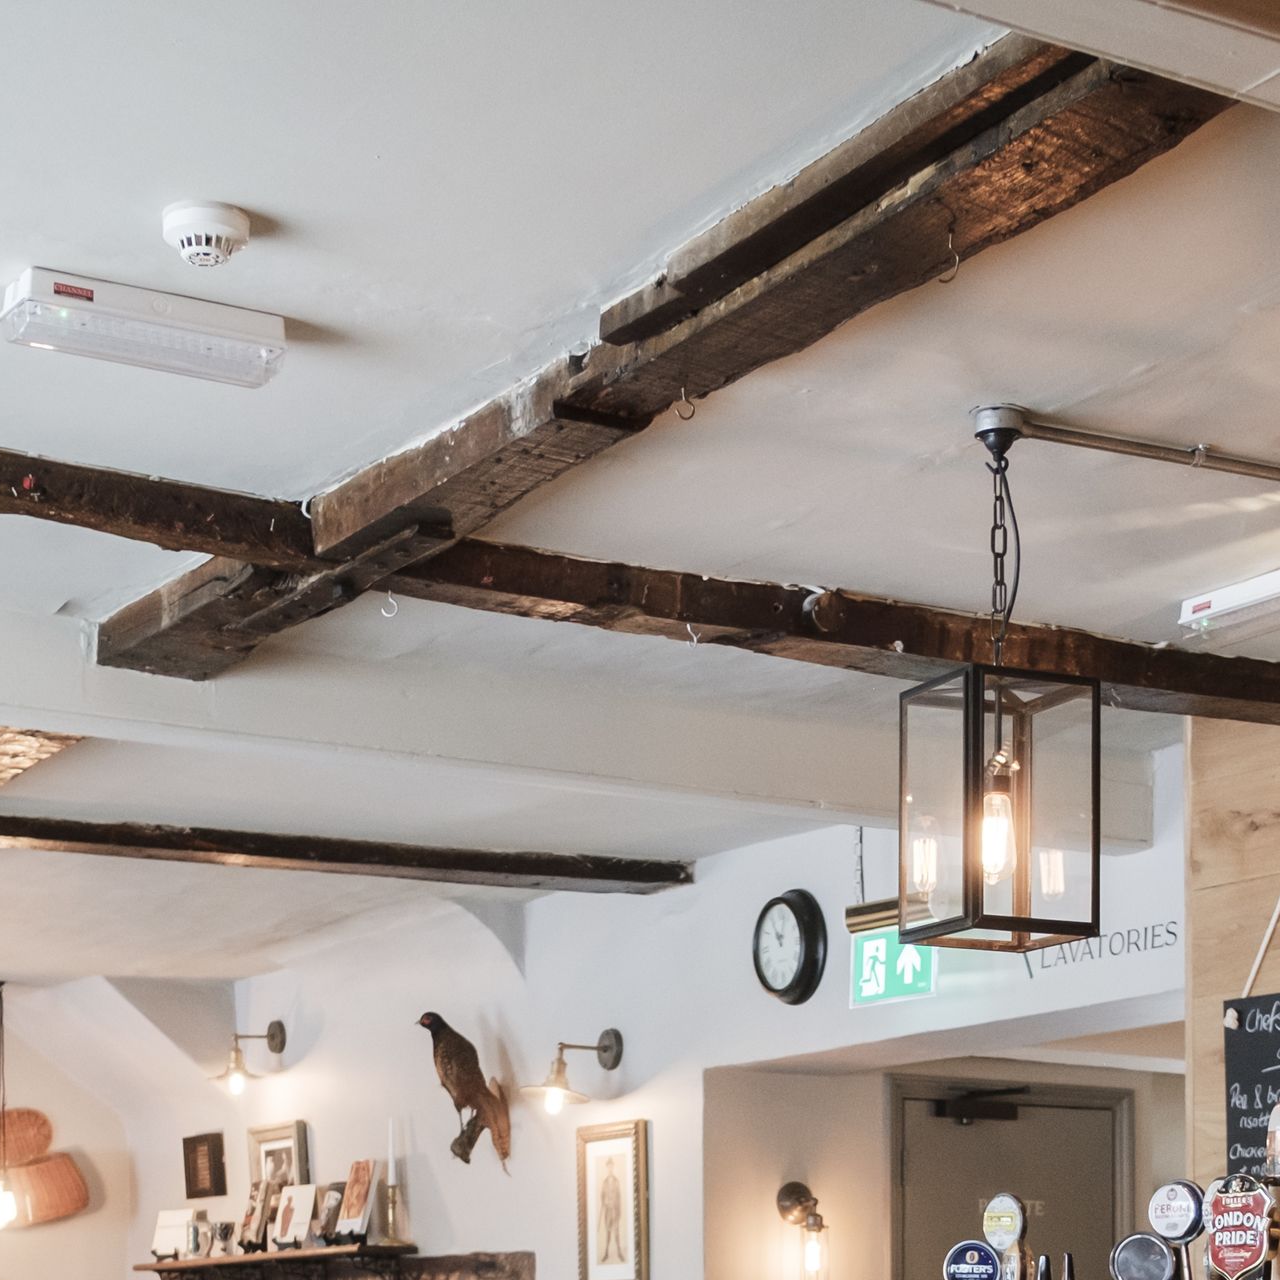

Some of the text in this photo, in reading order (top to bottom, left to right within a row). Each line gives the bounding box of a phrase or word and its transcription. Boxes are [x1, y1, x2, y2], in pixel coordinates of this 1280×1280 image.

[54, 283, 93, 298] CHANNEL
[1040, 920, 1179, 970] LAVATORIES
[1254, 1083, 1263, 1109] &
[1154, 1203, 1191, 1214] PERONI
[1210, 1210, 1270, 1234] LONDON
[1215, 1230, 1258, 1246] PRIDE
[949, 1263, 994, 1274] FOSTER'S
